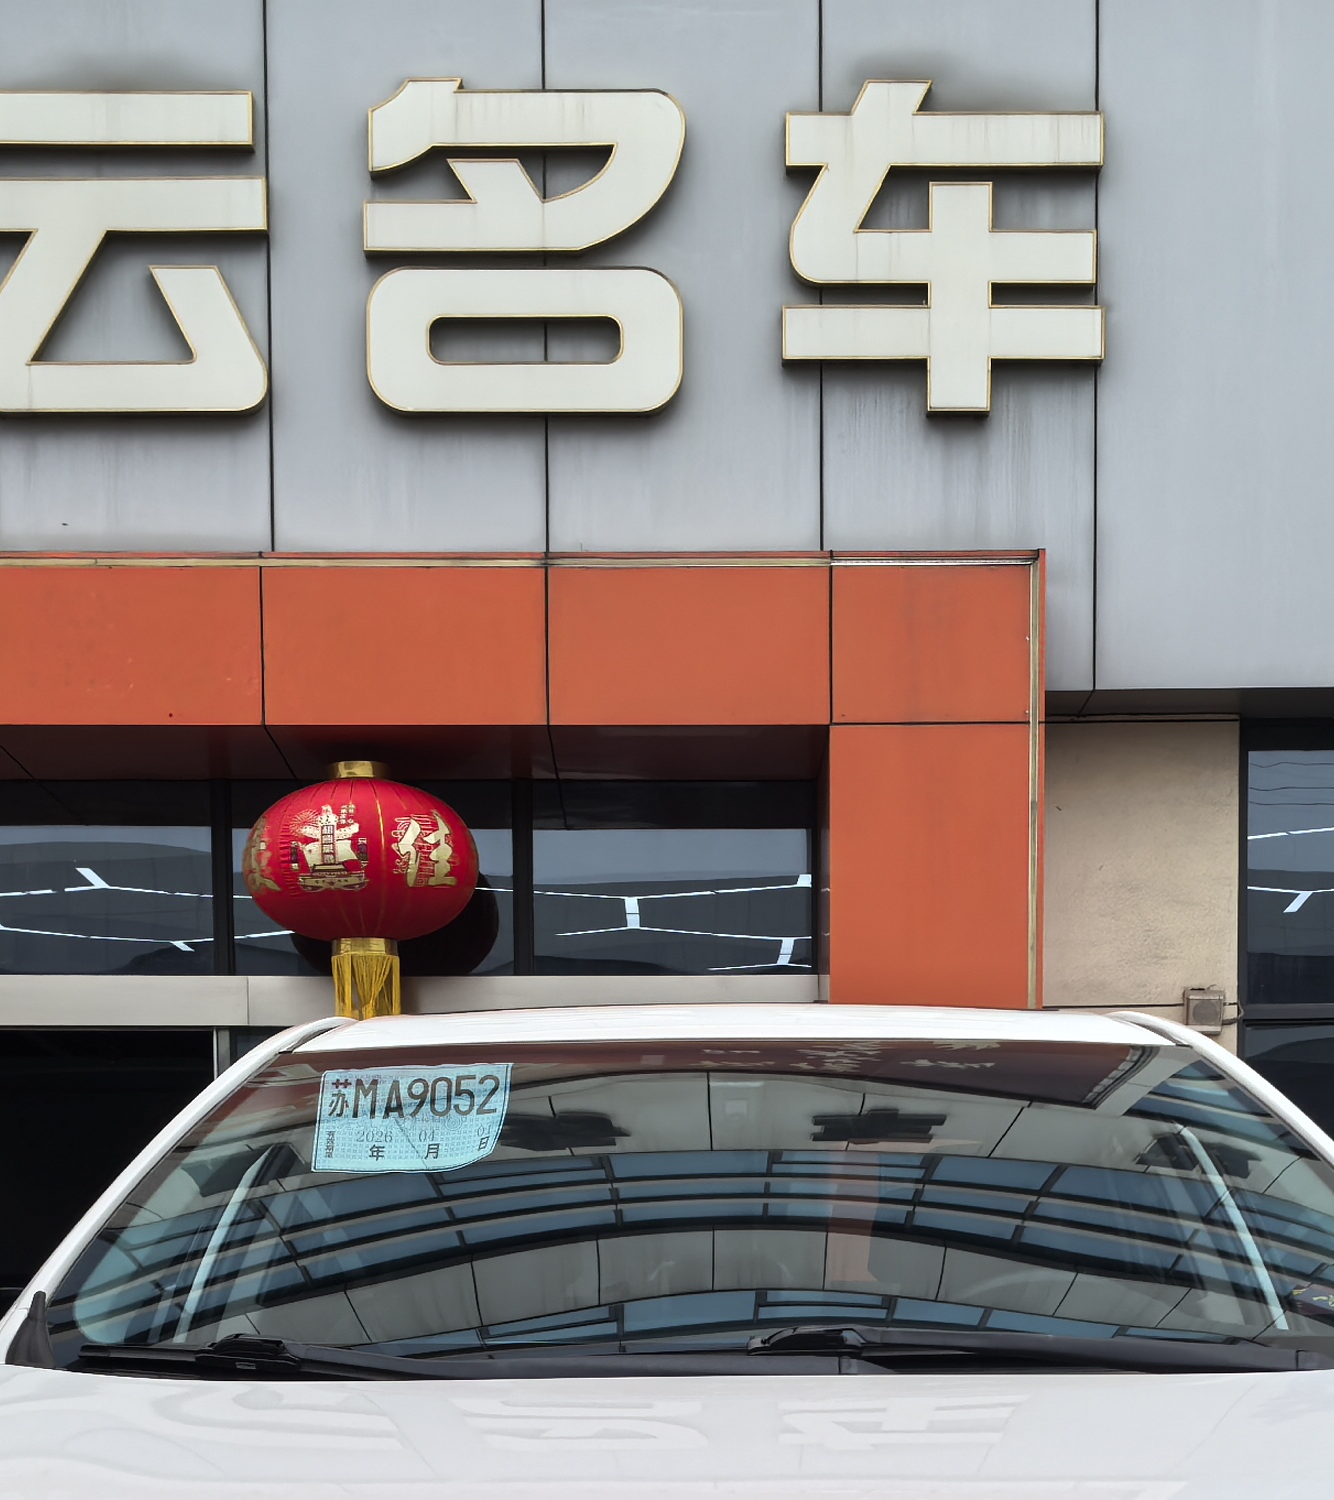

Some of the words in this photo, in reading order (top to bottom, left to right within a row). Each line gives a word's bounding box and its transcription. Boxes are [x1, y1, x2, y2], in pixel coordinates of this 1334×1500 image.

[328, 1075, 500, 1118] 苏MA9052
[368, 1144, 385, 1161] 年
[424, 1143, 440, 1159] 月
